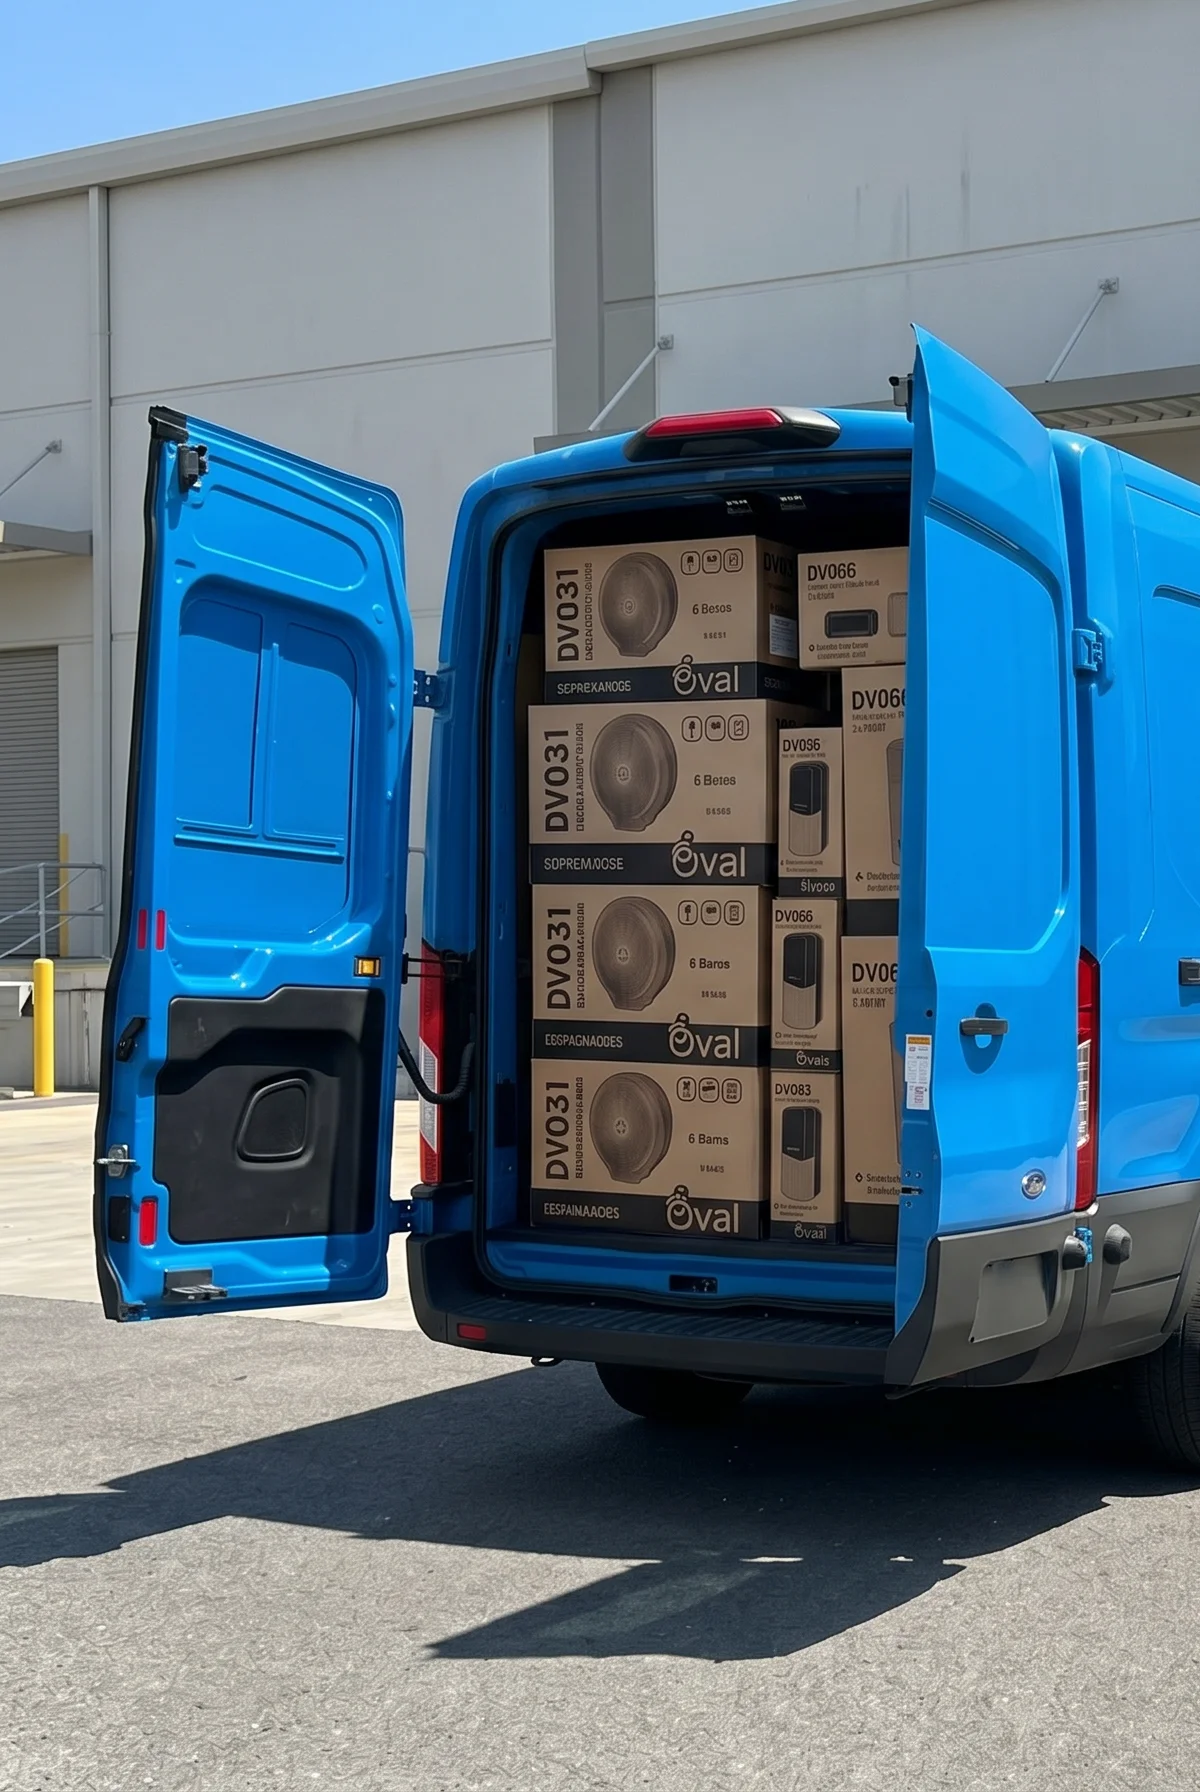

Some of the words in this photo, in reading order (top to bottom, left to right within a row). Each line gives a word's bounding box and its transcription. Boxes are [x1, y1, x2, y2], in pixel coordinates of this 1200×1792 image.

[807, 562, 857, 581] DV066
[556, 569, 580, 662] DV031
[692, 604, 699, 615] 6
[701, 603, 732, 614] Besos
[672, 655, 739, 695] Oval
[544, 730, 569, 832] DV031
[694, 774, 701, 786] 6
[672, 831, 746, 878] Oval
[775, 909, 814, 923] DV066
[547, 908, 571, 1010] DV031
[689, 958, 696, 969] 6
[699, 957, 730, 969] Baros
[668, 1013, 740, 1060] Oval
[775, 1083, 812, 1097] DV083
[545, 1081, 570, 1181] DV031
[688, 1133, 695, 1144] 6
[698, 1133, 729, 1146] Bams
[666, 1185, 739, 1234] Oval
